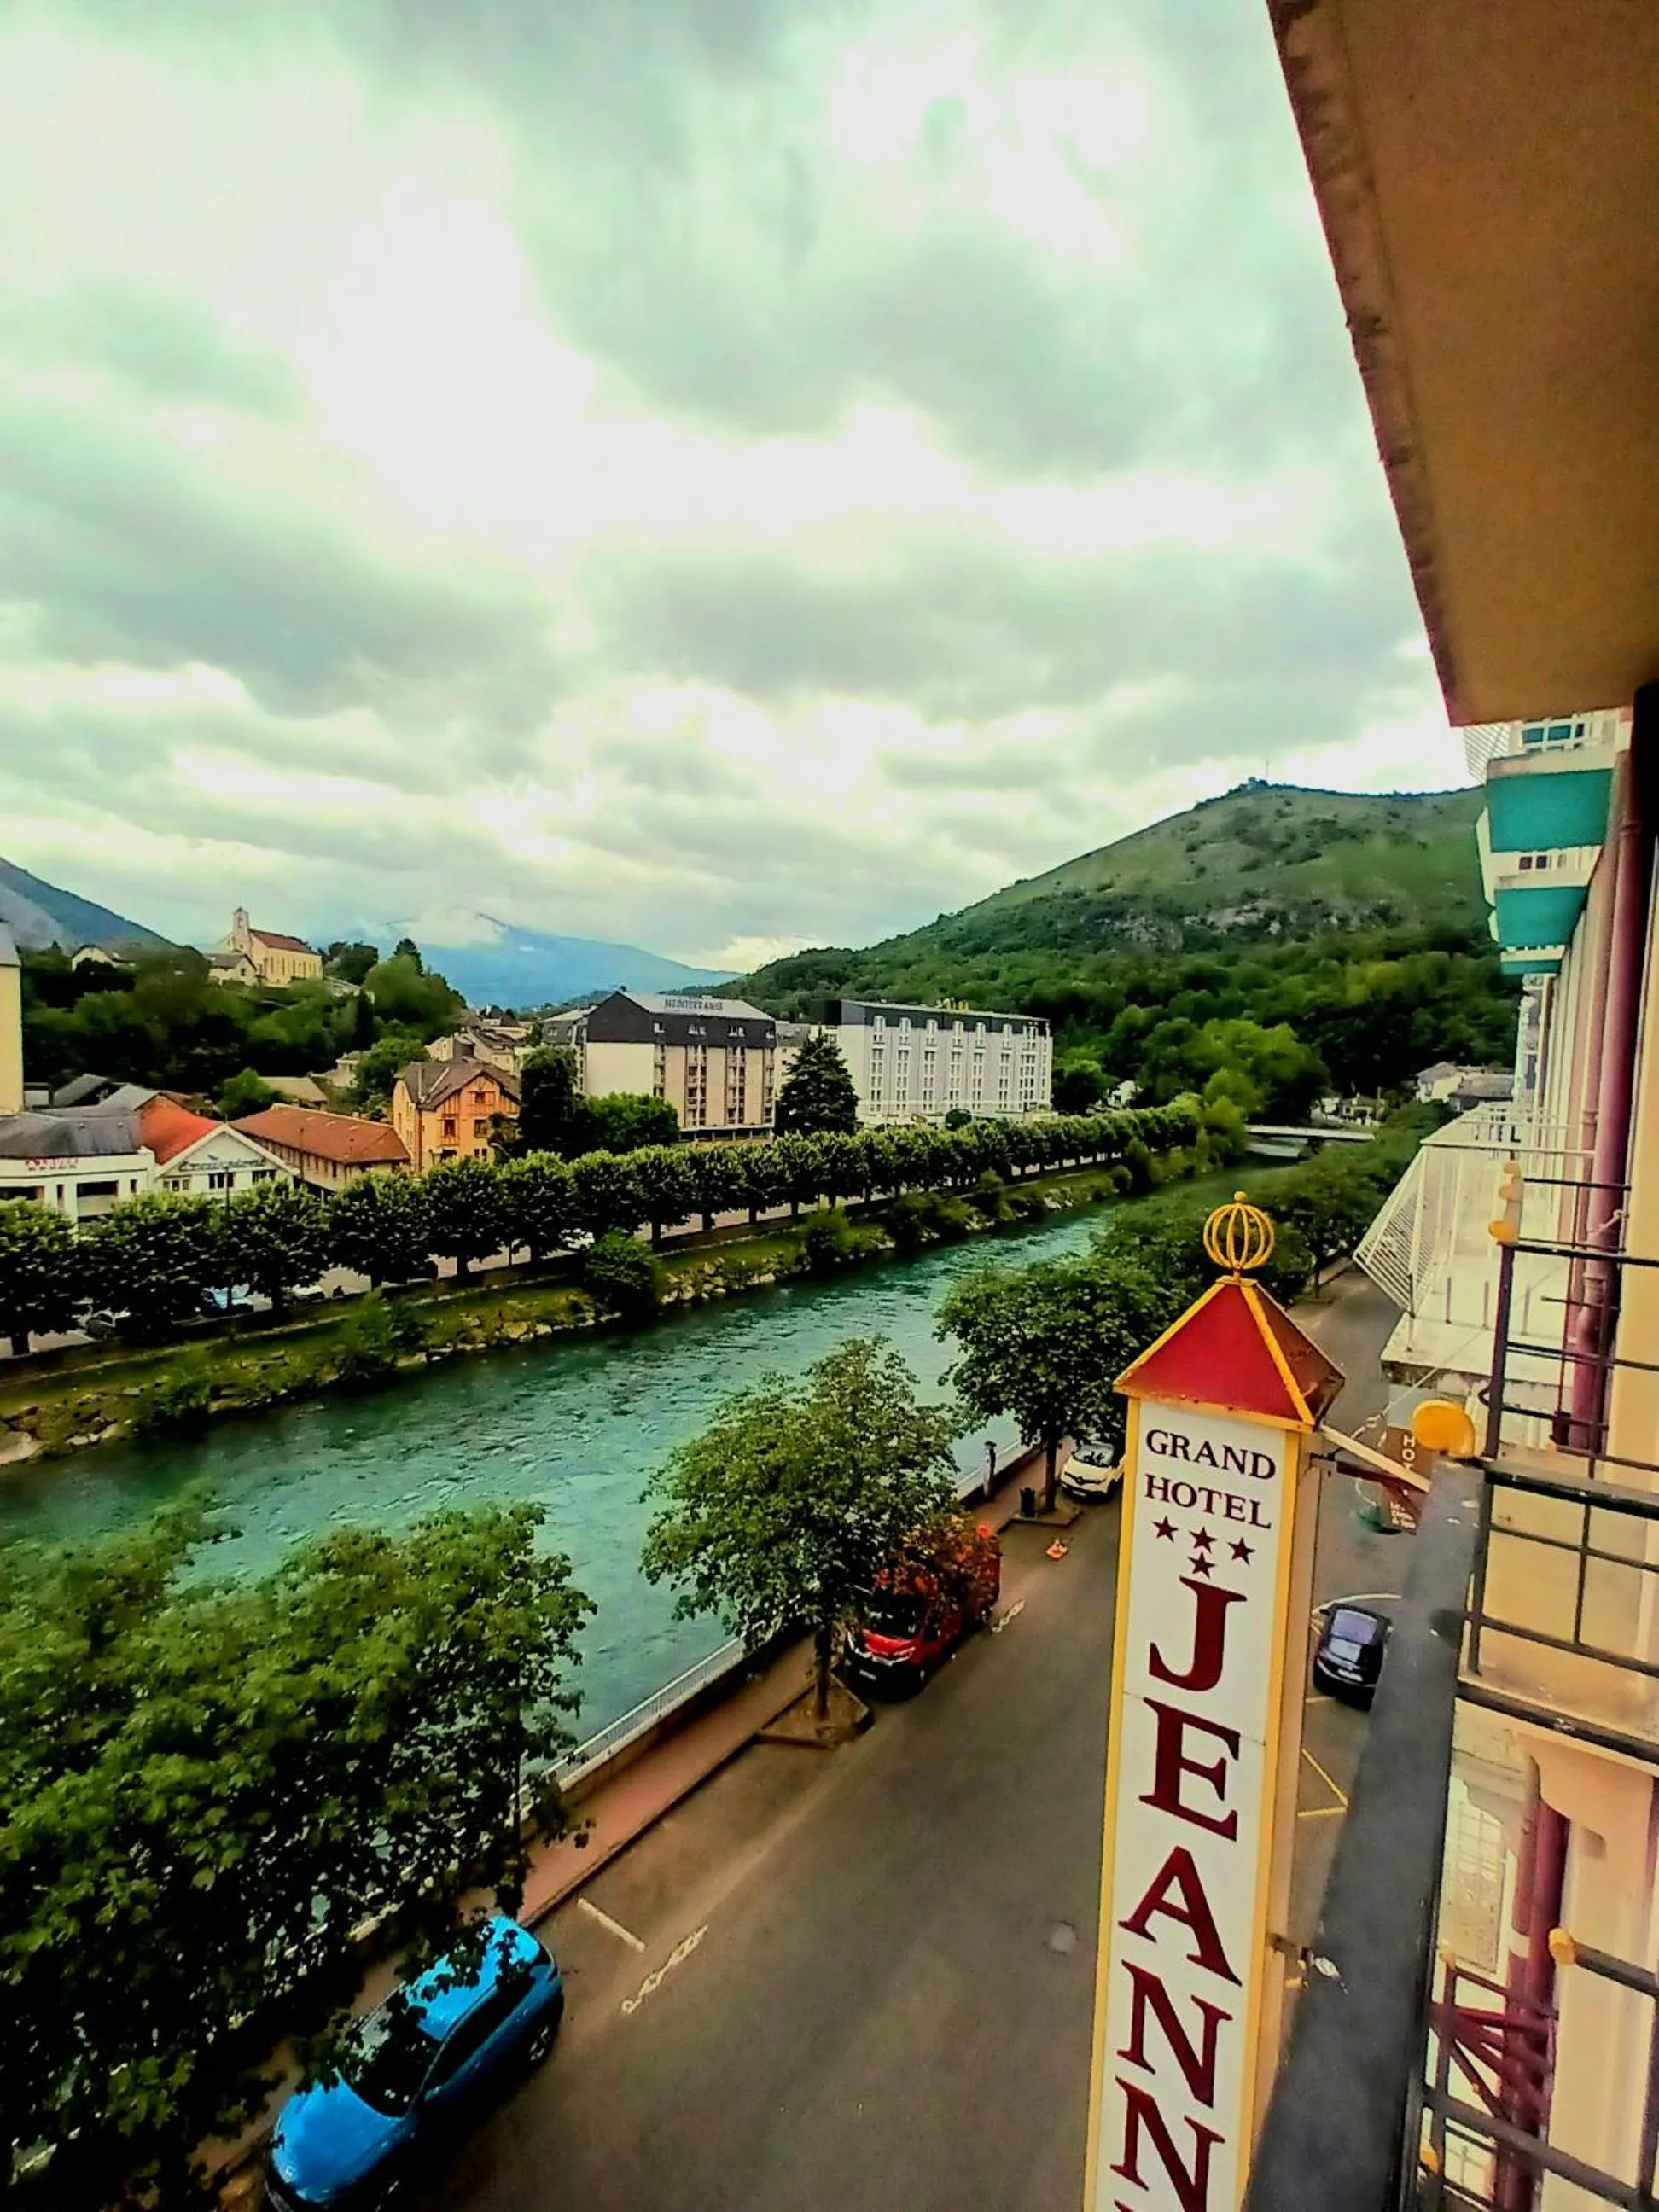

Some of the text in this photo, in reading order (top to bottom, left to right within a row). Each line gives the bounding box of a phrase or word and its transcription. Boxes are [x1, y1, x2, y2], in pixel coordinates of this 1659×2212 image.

[1145, 1429, 1277, 1480] GRAND
[1144, 1473, 1272, 1530] HOTEL
[1109, 1575, 1248, 2212] JEANN
